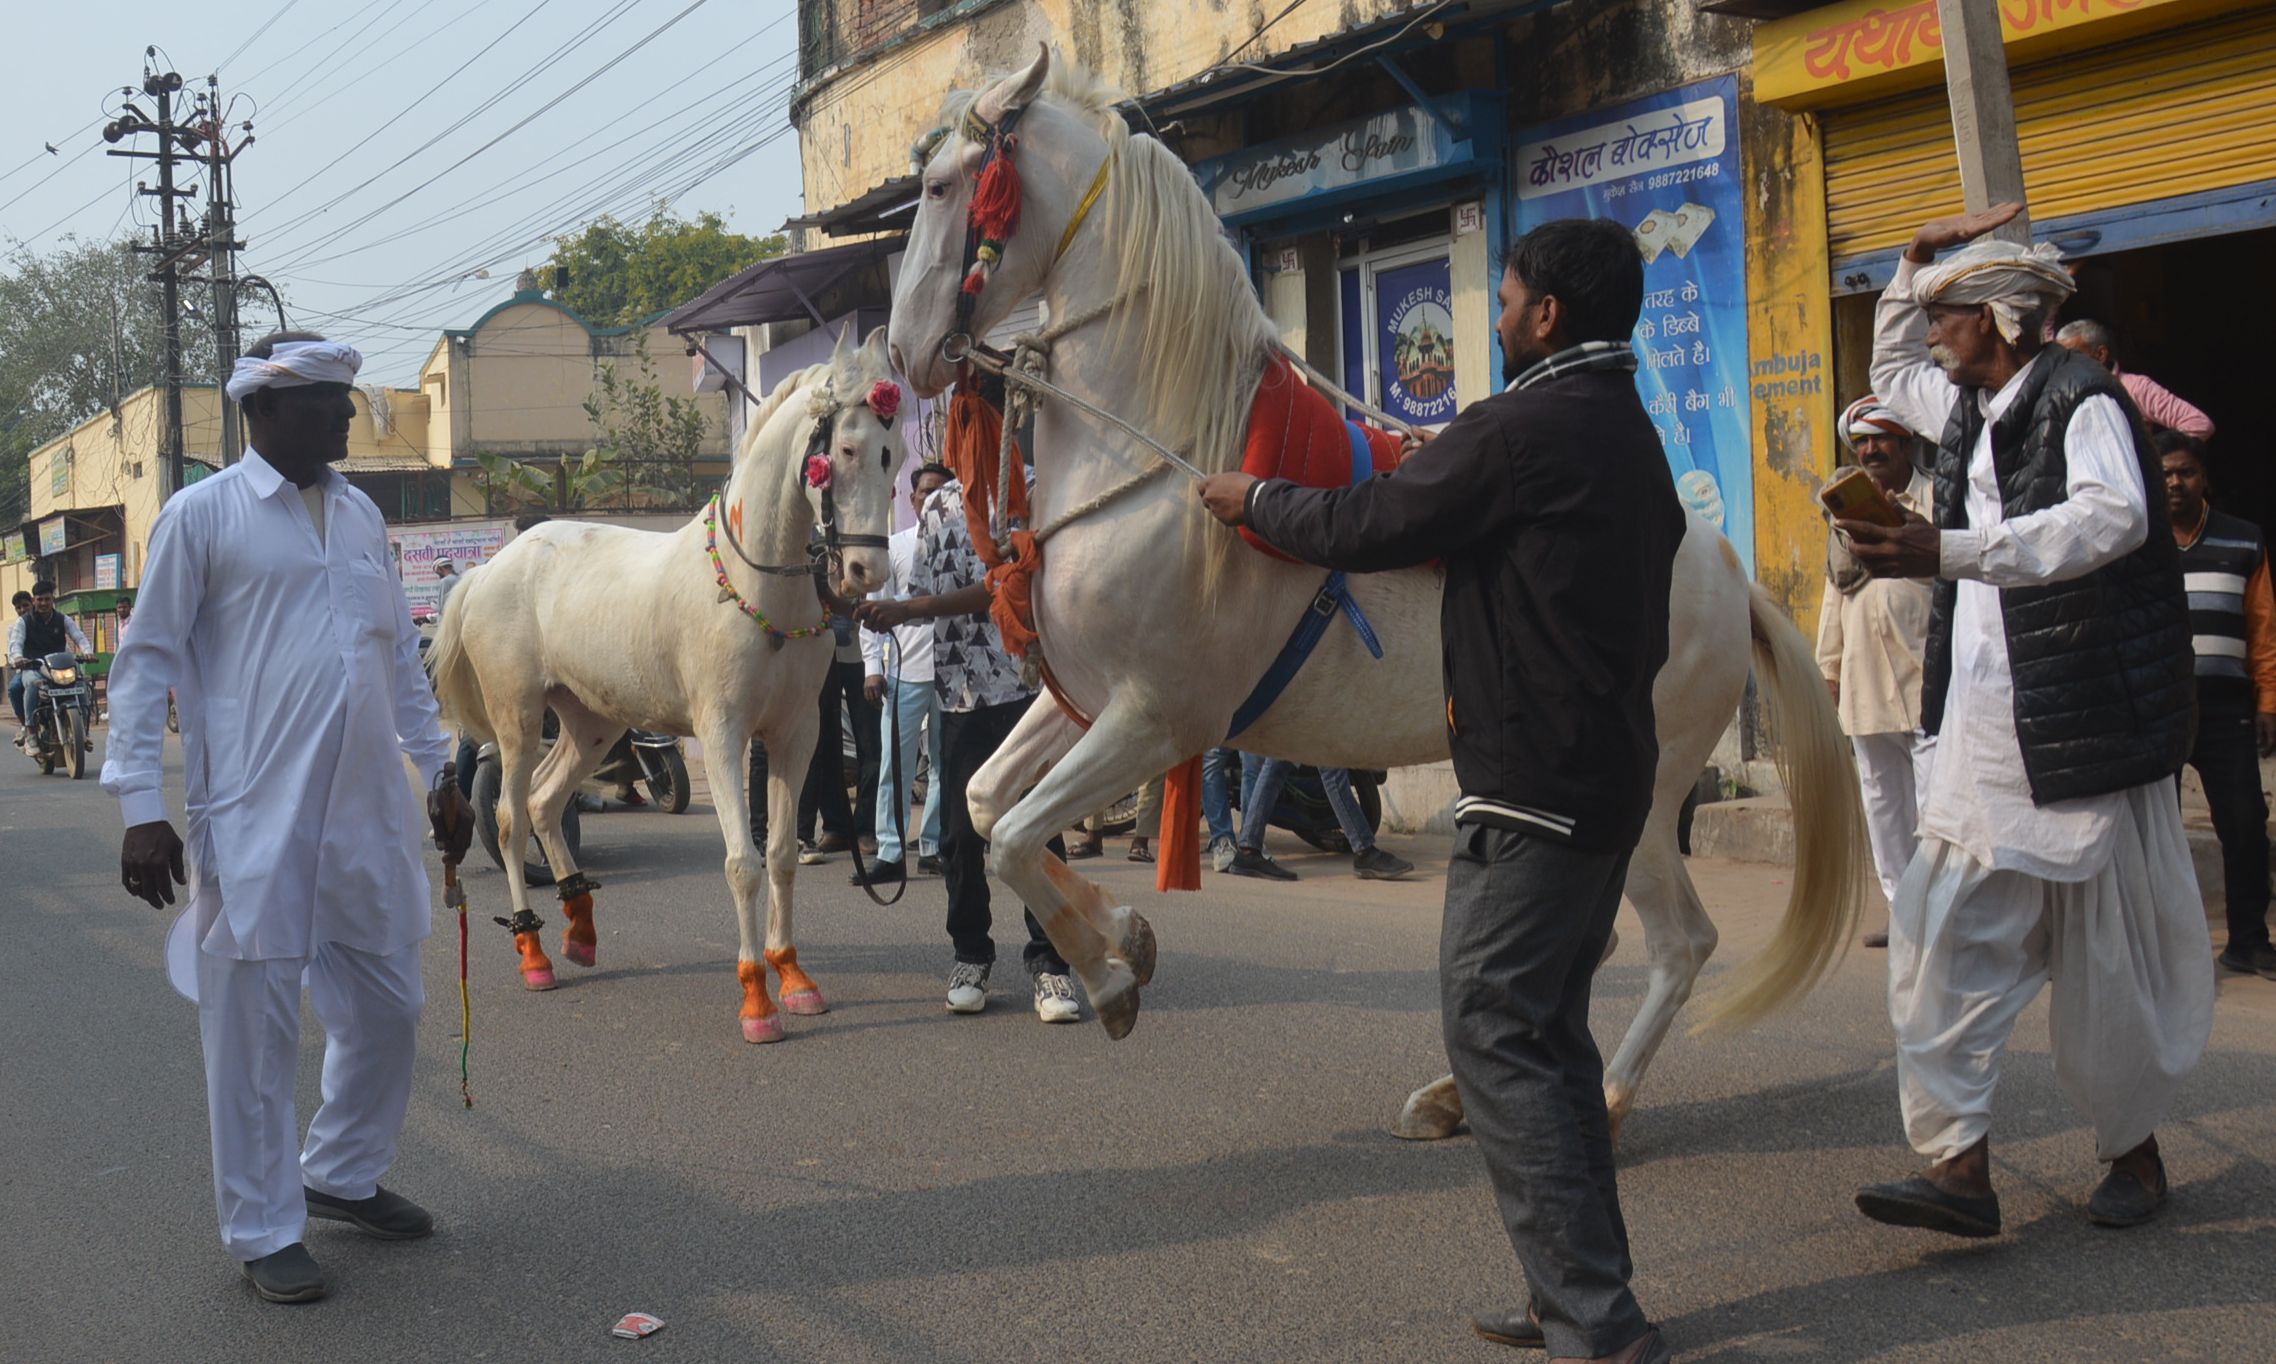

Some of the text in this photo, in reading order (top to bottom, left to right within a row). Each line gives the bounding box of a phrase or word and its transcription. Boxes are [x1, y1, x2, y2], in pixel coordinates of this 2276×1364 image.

[1648, 162, 1720, 191] 9887221648
[1644, 280, 1699, 310] तरह के
[1387, 286, 1453, 335] MUKESH SA
[1662, 311, 1700, 337] डिब्बे
[1645, 344, 1686, 370] मिलते
[1752, 349, 1821, 377] mbuja
[1402, 379, 1457, 417] 98872216
[1685, 388, 1710, 412] बैग
[1718, 384, 1736, 408] भी
[1753, 374, 1822, 400] ement
